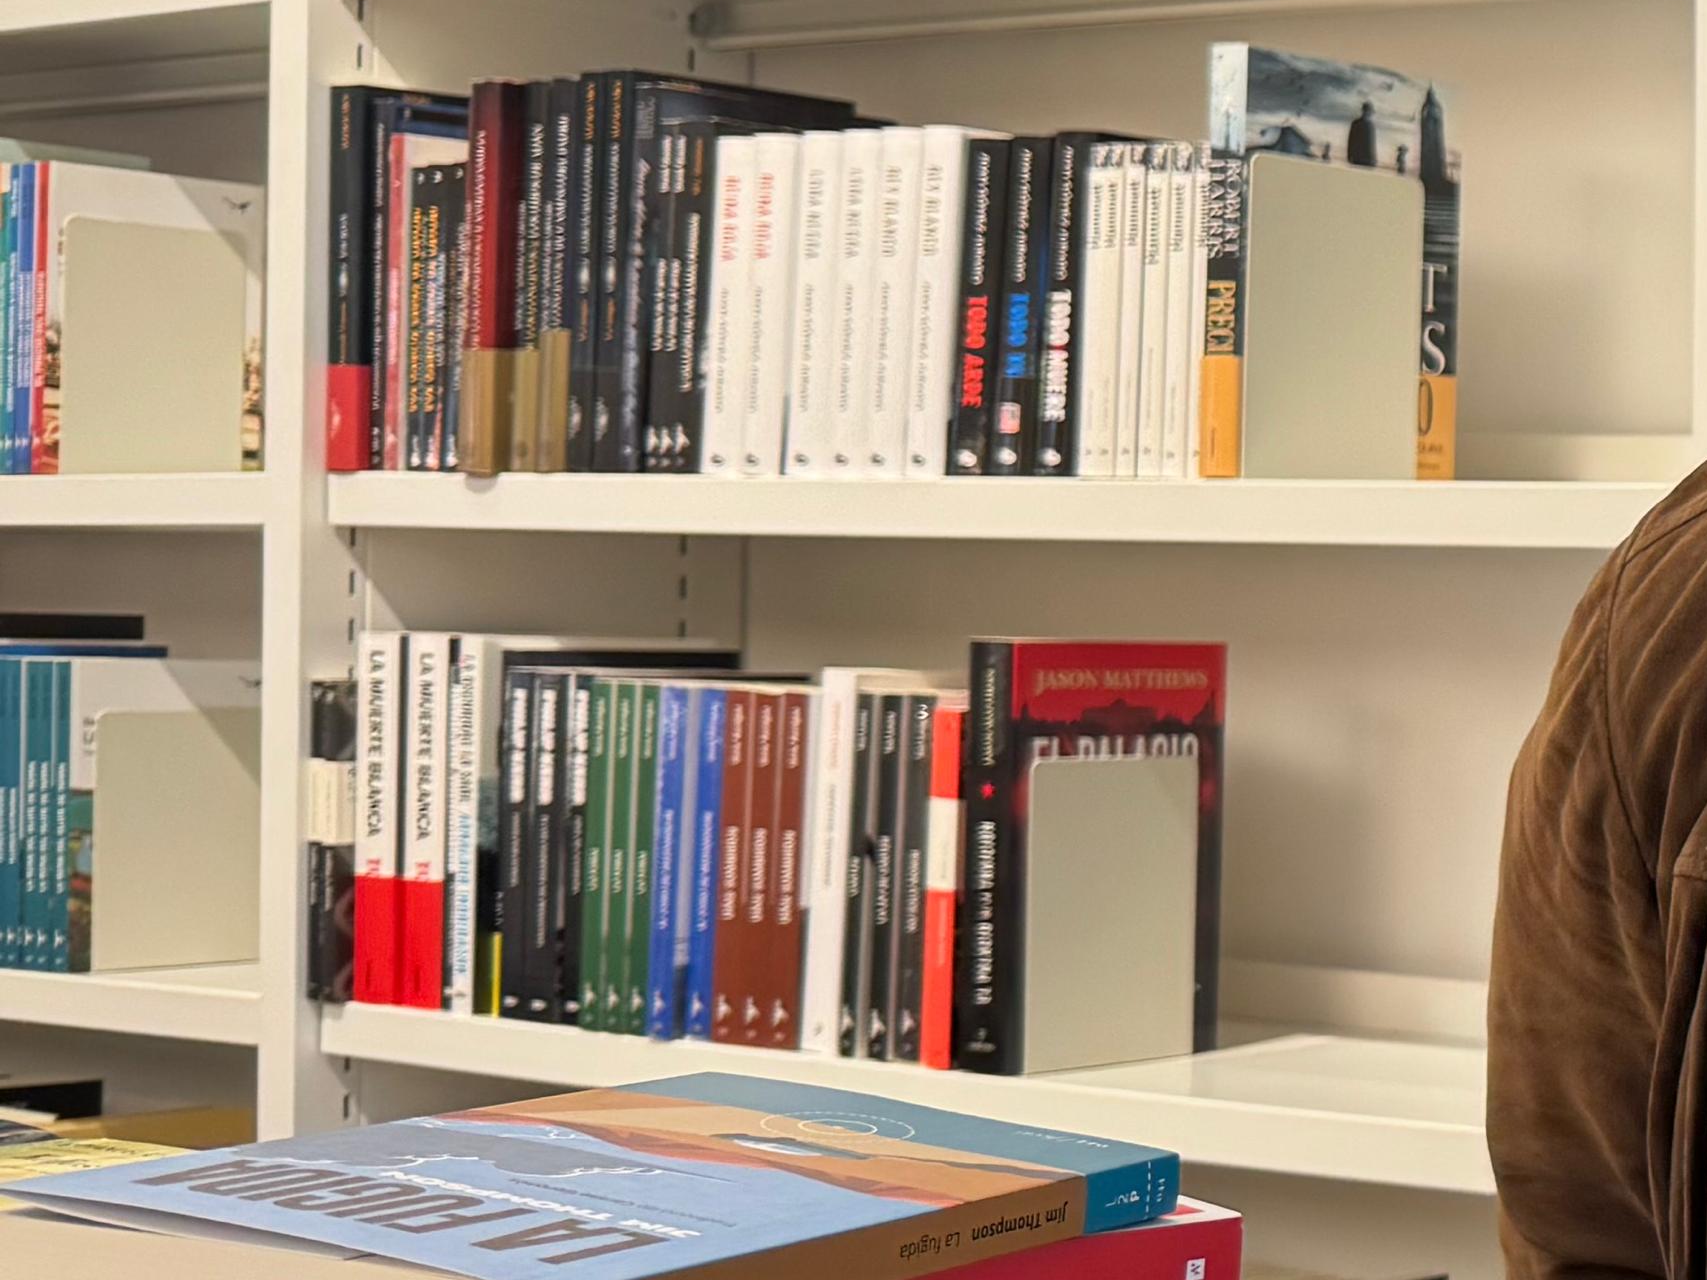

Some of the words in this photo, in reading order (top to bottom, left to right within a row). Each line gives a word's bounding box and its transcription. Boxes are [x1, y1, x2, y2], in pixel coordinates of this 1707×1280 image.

[1034, 669, 1101, 696] JASON
[1104, 668, 1209, 694] MATTHEWS
[129, 1159, 539, 1235] FUGIDA
[970, 1211, 1038, 1242] Thompson
[1042, 1205, 1069, 1227] Jim
[469, 1218, 673, 1266] LA
[900, 1233, 942, 1260] fugida
[945, 1230, 961, 1249] La
